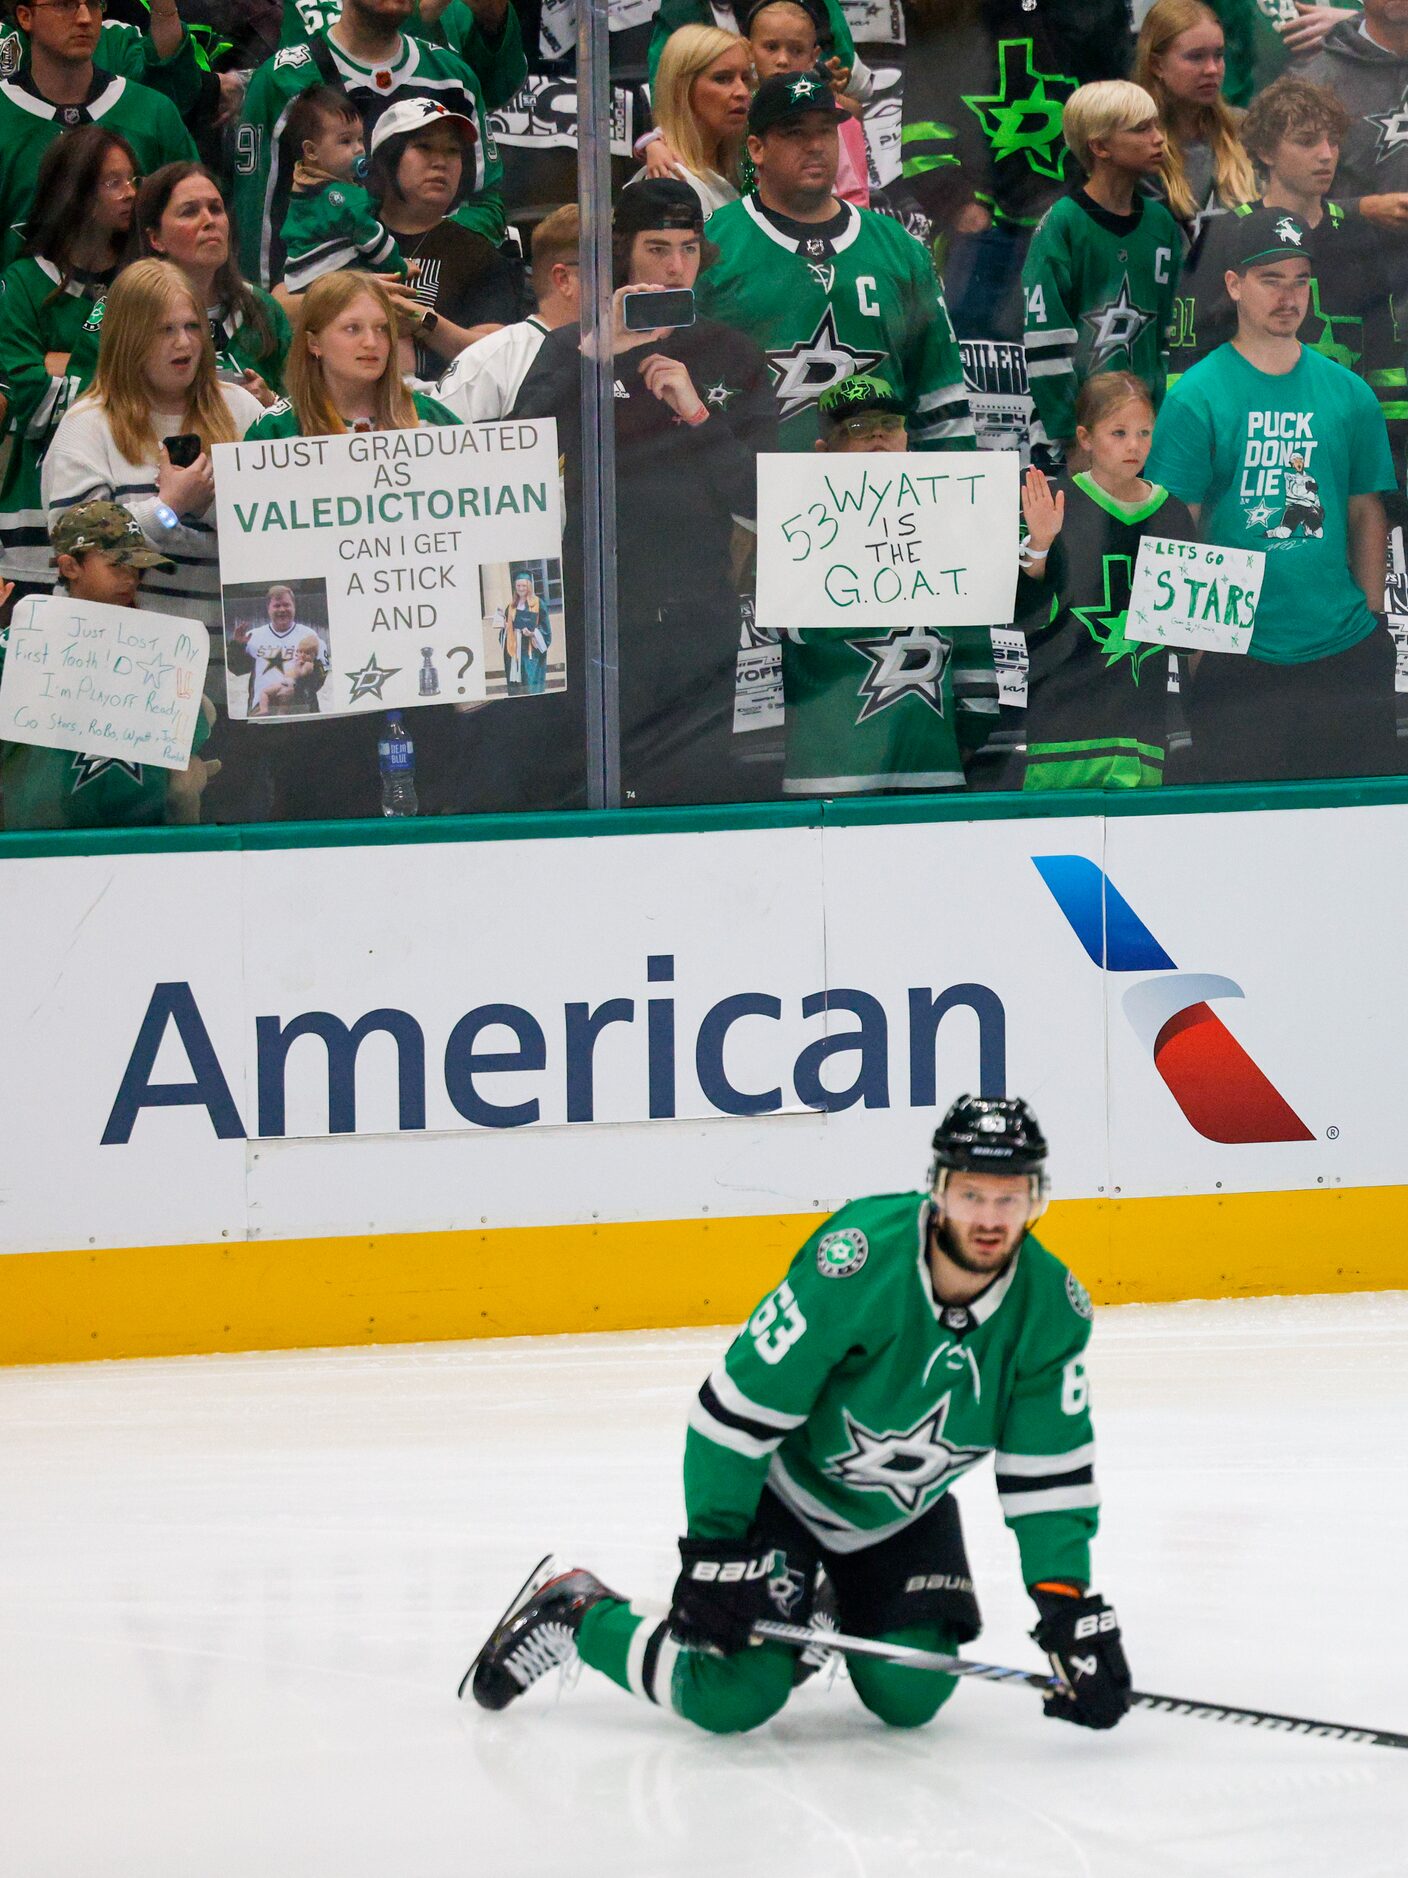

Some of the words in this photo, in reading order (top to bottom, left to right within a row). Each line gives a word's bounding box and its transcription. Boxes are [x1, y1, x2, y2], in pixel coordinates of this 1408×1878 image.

[1155, 247, 1171, 284] C
[856, 276, 880, 317] C
[1247, 410, 1314, 439] PUCK
[234, 447, 241, 471] I
[252, 439, 330, 470] JUST
[349, 424, 539, 462] GRADUATED
[1244, 439, 1318, 468] DON'T
[373, 461, 412, 488] AS
[1239, 468, 1282, 497] LIE
[233, 481, 548, 533] VALEDICTORIAN
[781, 502, 839, 562] 53
[824, 470, 986, 528] WYATT
[882, 512, 917, 538] IS
[338, 536, 391, 560] CAN
[400, 535, 406, 556] I
[414, 530, 462, 554] GET
[865, 540, 922, 565] THE
[1155, 541, 1198, 560] LET'S
[1205, 551, 1225, 566] GO
[346, 572, 365, 596] A
[374, 564, 457, 594] STICK
[1153, 570, 1255, 629] STARS
[14, 599, 48, 632] I
[371, 603, 438, 632] AND
[391, 753, 408, 765] BLUE
[626, 790, 636, 799] 74
[100, 954, 1008, 1146] American
[750, 1282, 808, 1366] 63
[1060, 1358, 1092, 1417] 6
